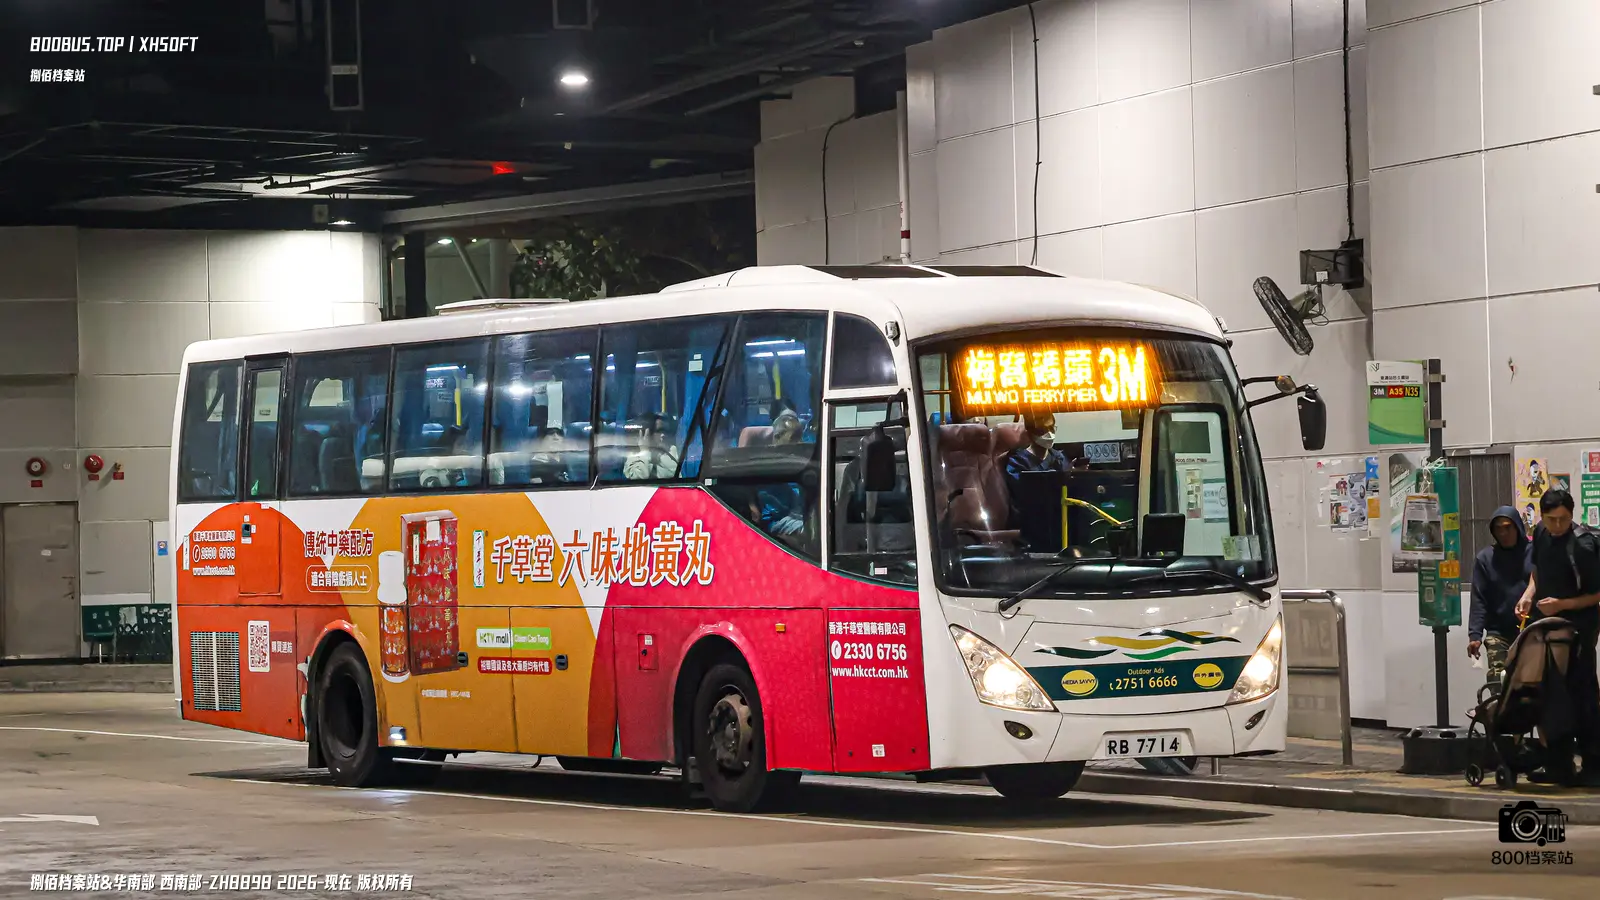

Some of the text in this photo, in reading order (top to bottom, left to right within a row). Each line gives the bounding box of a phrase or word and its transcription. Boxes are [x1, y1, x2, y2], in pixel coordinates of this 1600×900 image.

[966, 346, 1147, 403] 梅窩碼頭 3M
[967, 388, 1098, 404] MUI WO FERRY PIER
[1373, 388, 1385, 396] 3M
[1405, 387, 1419, 396] N35
[304, 528, 374, 557] 傳統中藥配方
[491, 519, 714, 588] 千草堂 六味地黃丸
[828, 622, 906, 636] 香港千草堂醫藥有限公司
[843, 643, 907, 660] 2330 6756
[832, 665, 909, 679] www.hkcct.com.hk
[1128, 667, 1165, 676] Outdoor Ads
[1115, 675, 1178, 690] 2751 6666
[1108, 737, 1178, 754] RB 7714
